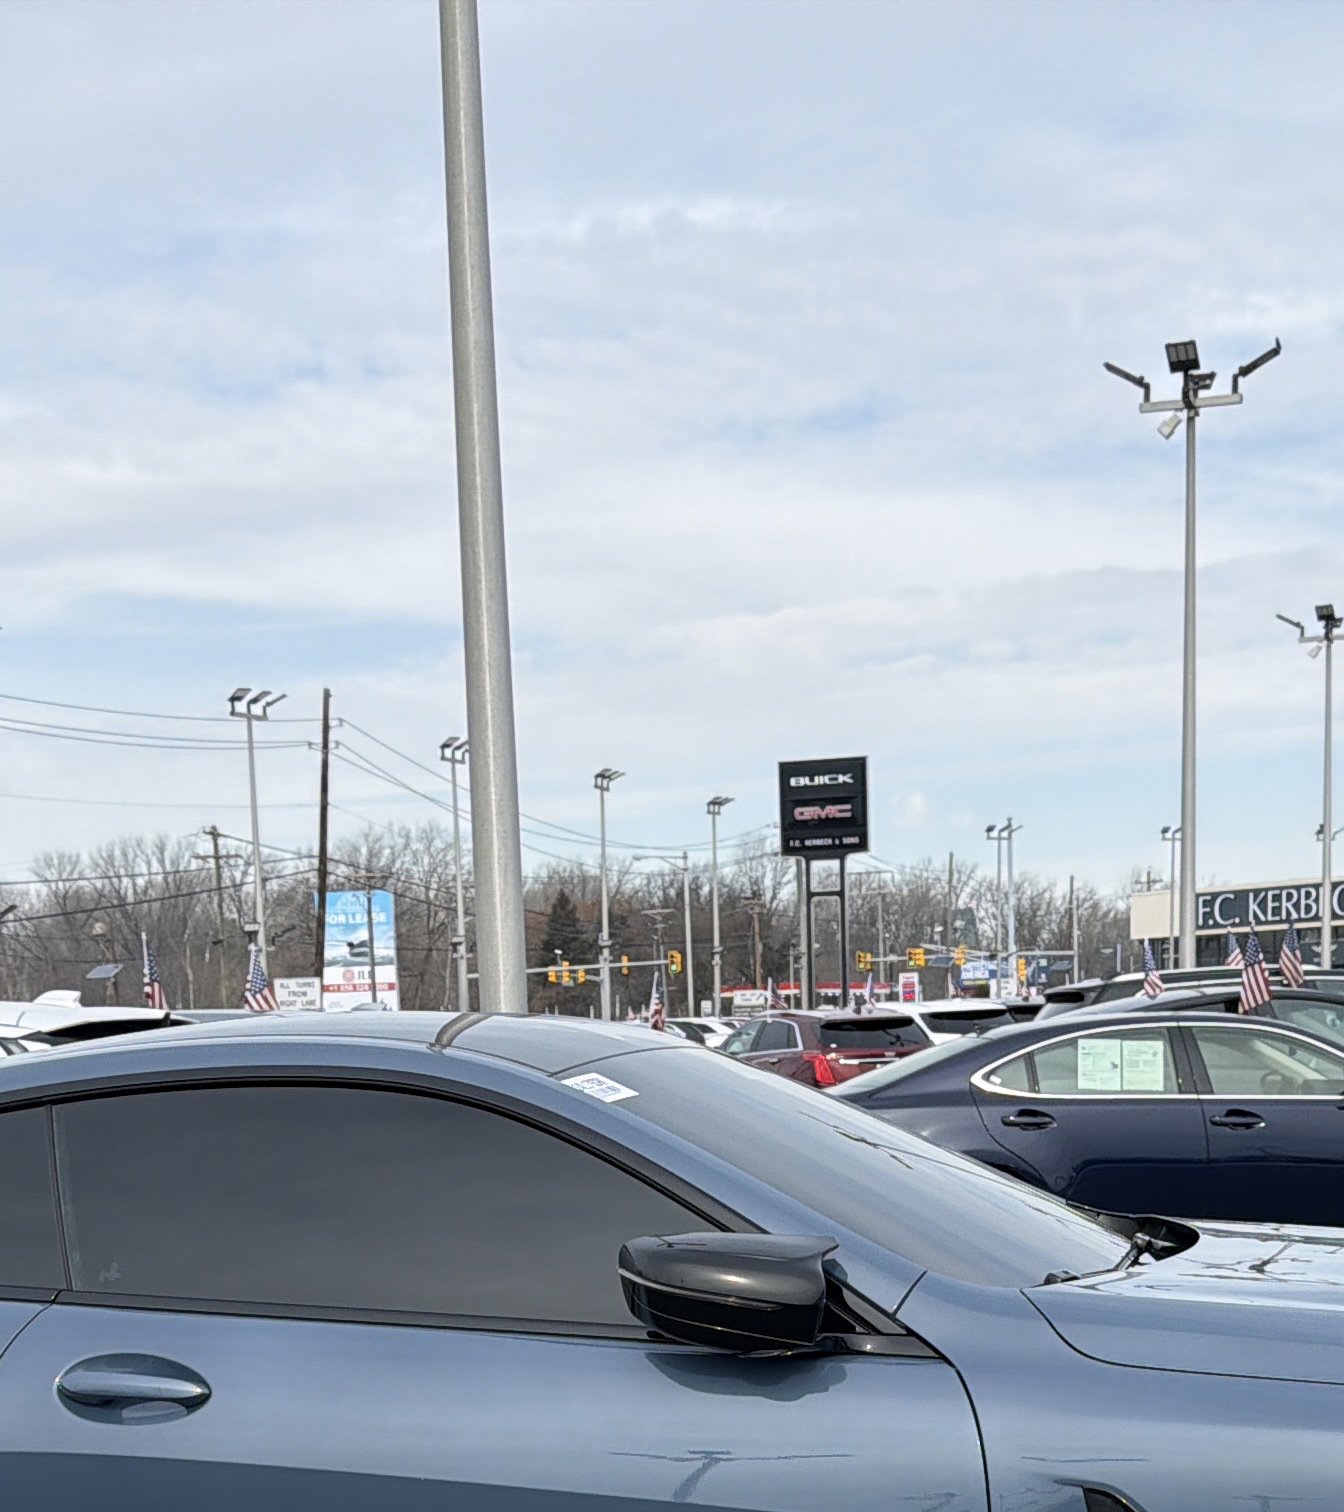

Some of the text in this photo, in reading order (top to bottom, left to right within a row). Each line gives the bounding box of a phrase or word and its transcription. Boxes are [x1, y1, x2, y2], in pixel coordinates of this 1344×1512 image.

[789, 773, 854, 787] BUICK
[794, 803, 852, 820] GMC
[1197, 893, 1240, 926] F.C.
[325, 914, 346, 925] OR
